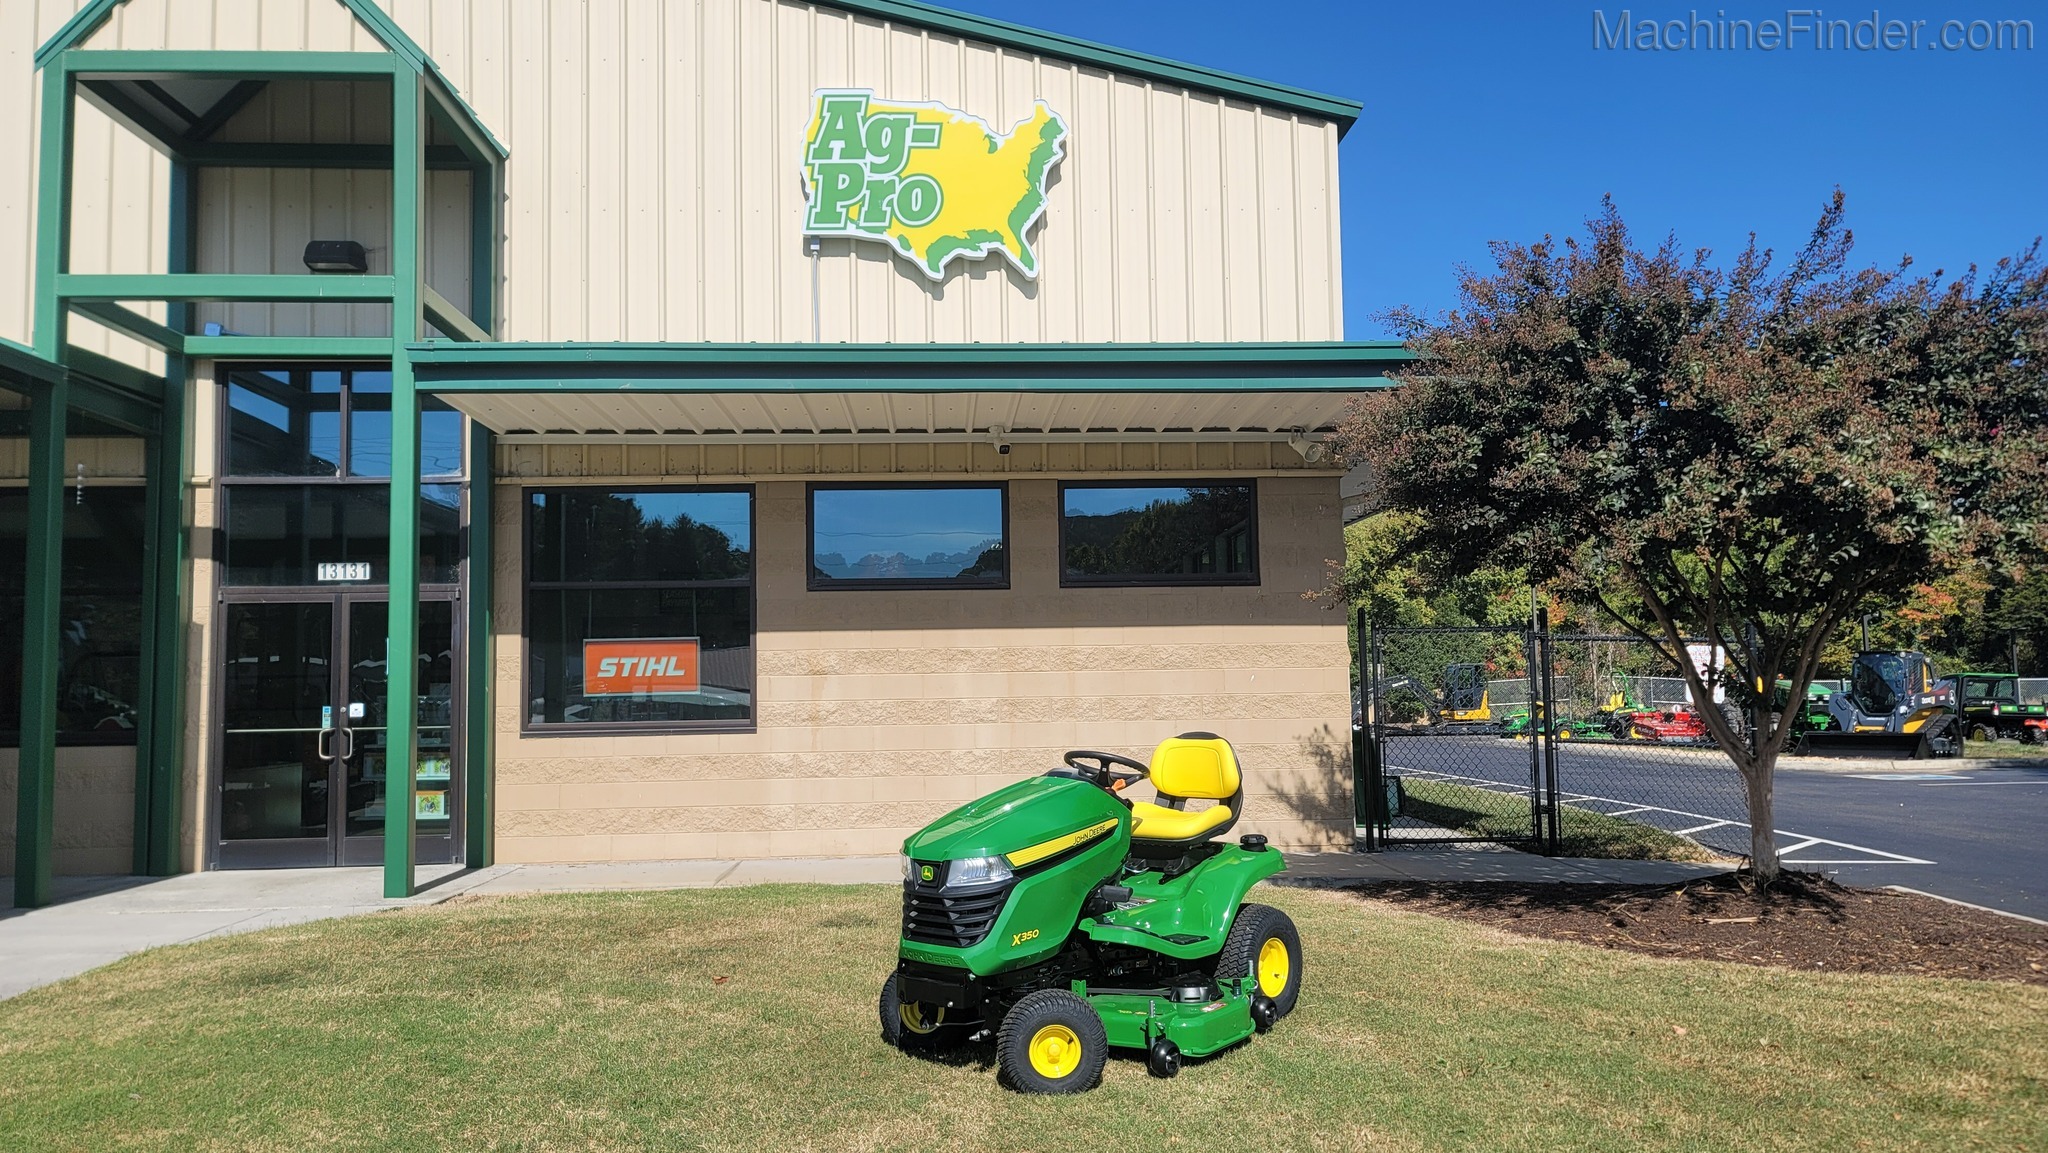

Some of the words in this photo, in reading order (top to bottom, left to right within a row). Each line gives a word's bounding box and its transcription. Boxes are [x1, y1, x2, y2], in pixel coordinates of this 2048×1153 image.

[807, 95, 942, 174] Ag-
[806, 163, 944, 229] Pro
[320, 563, 368, 579] 13131
[597, 656, 686, 678] STIHL
[1011, 929, 1040, 947] X350
